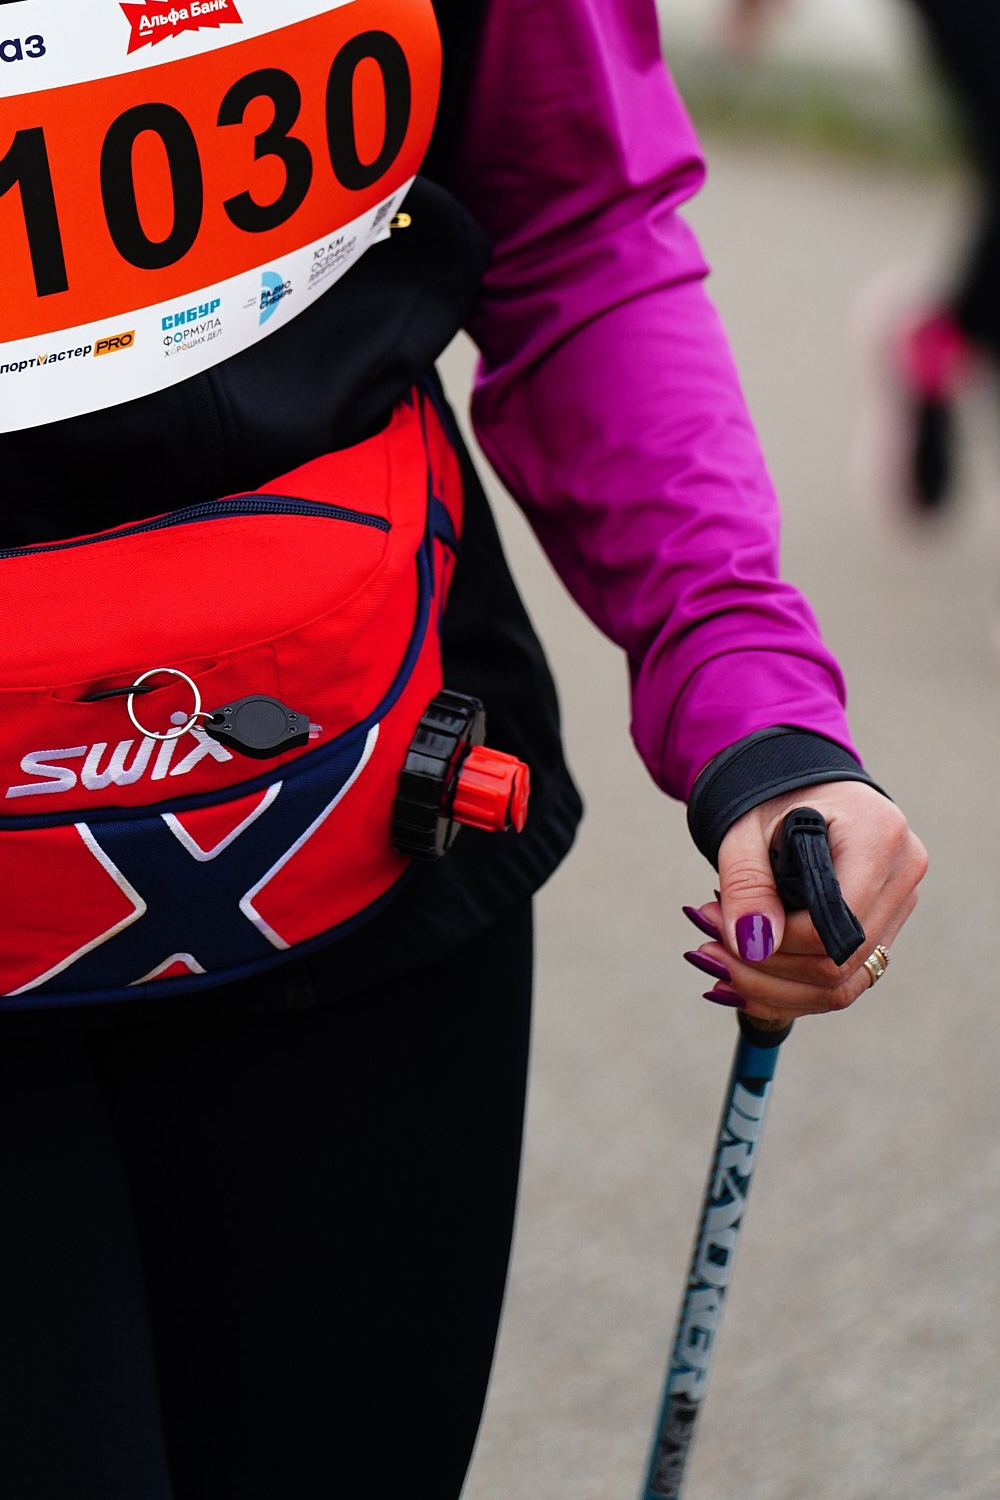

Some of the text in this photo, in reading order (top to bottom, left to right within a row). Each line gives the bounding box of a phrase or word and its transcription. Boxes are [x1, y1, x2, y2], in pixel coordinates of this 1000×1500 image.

[138, 8, 189, 35] Альфа
[162, 297, 221, 331] СИБУР
[96, 334, 133, 354] PRO
[163, 317, 222, 346] ФОРМУЛА
[207, 328, 222, 343] ДЕЛ
